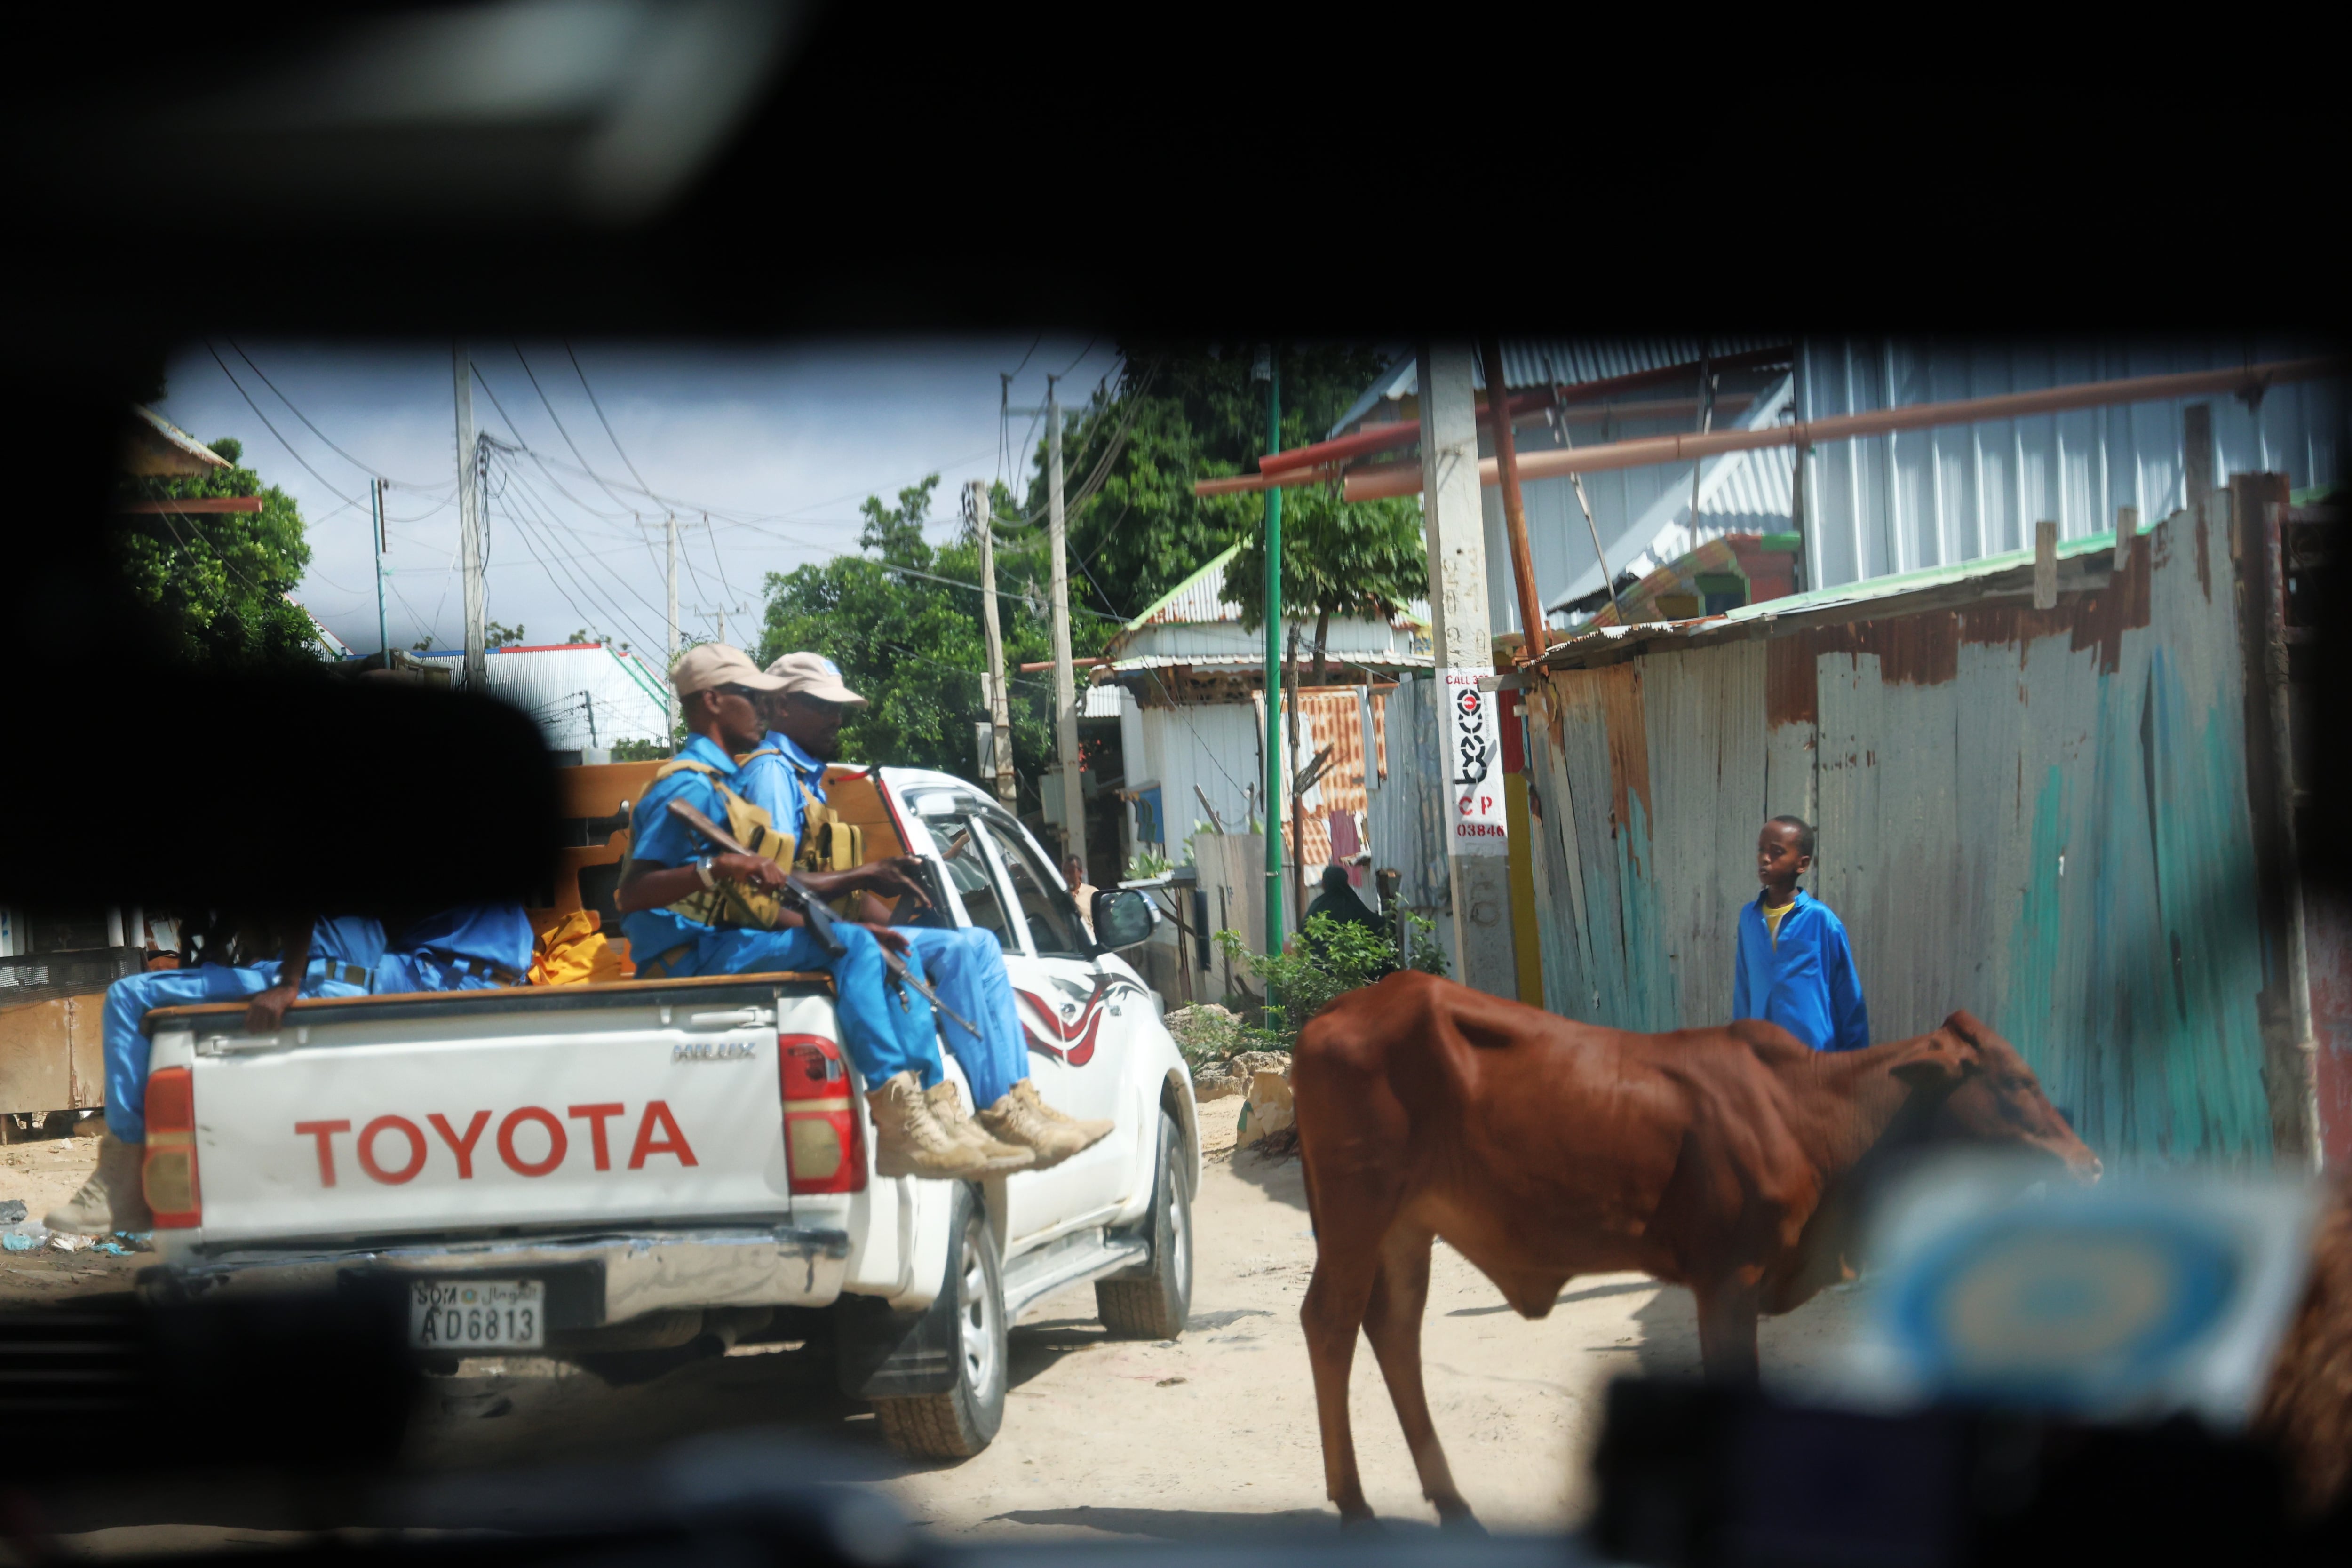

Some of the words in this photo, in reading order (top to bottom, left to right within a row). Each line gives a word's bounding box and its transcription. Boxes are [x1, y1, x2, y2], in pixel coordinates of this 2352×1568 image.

[1446, 675, 1470, 685] CALL
[1457, 824, 1505, 837] 03846
[673, 1042, 756, 1061] HILUX
[294, 1100, 699, 1188] TOYOTA
[417, 1287, 457, 1305] SOM
[421, 1308, 533, 1342] AD6813
